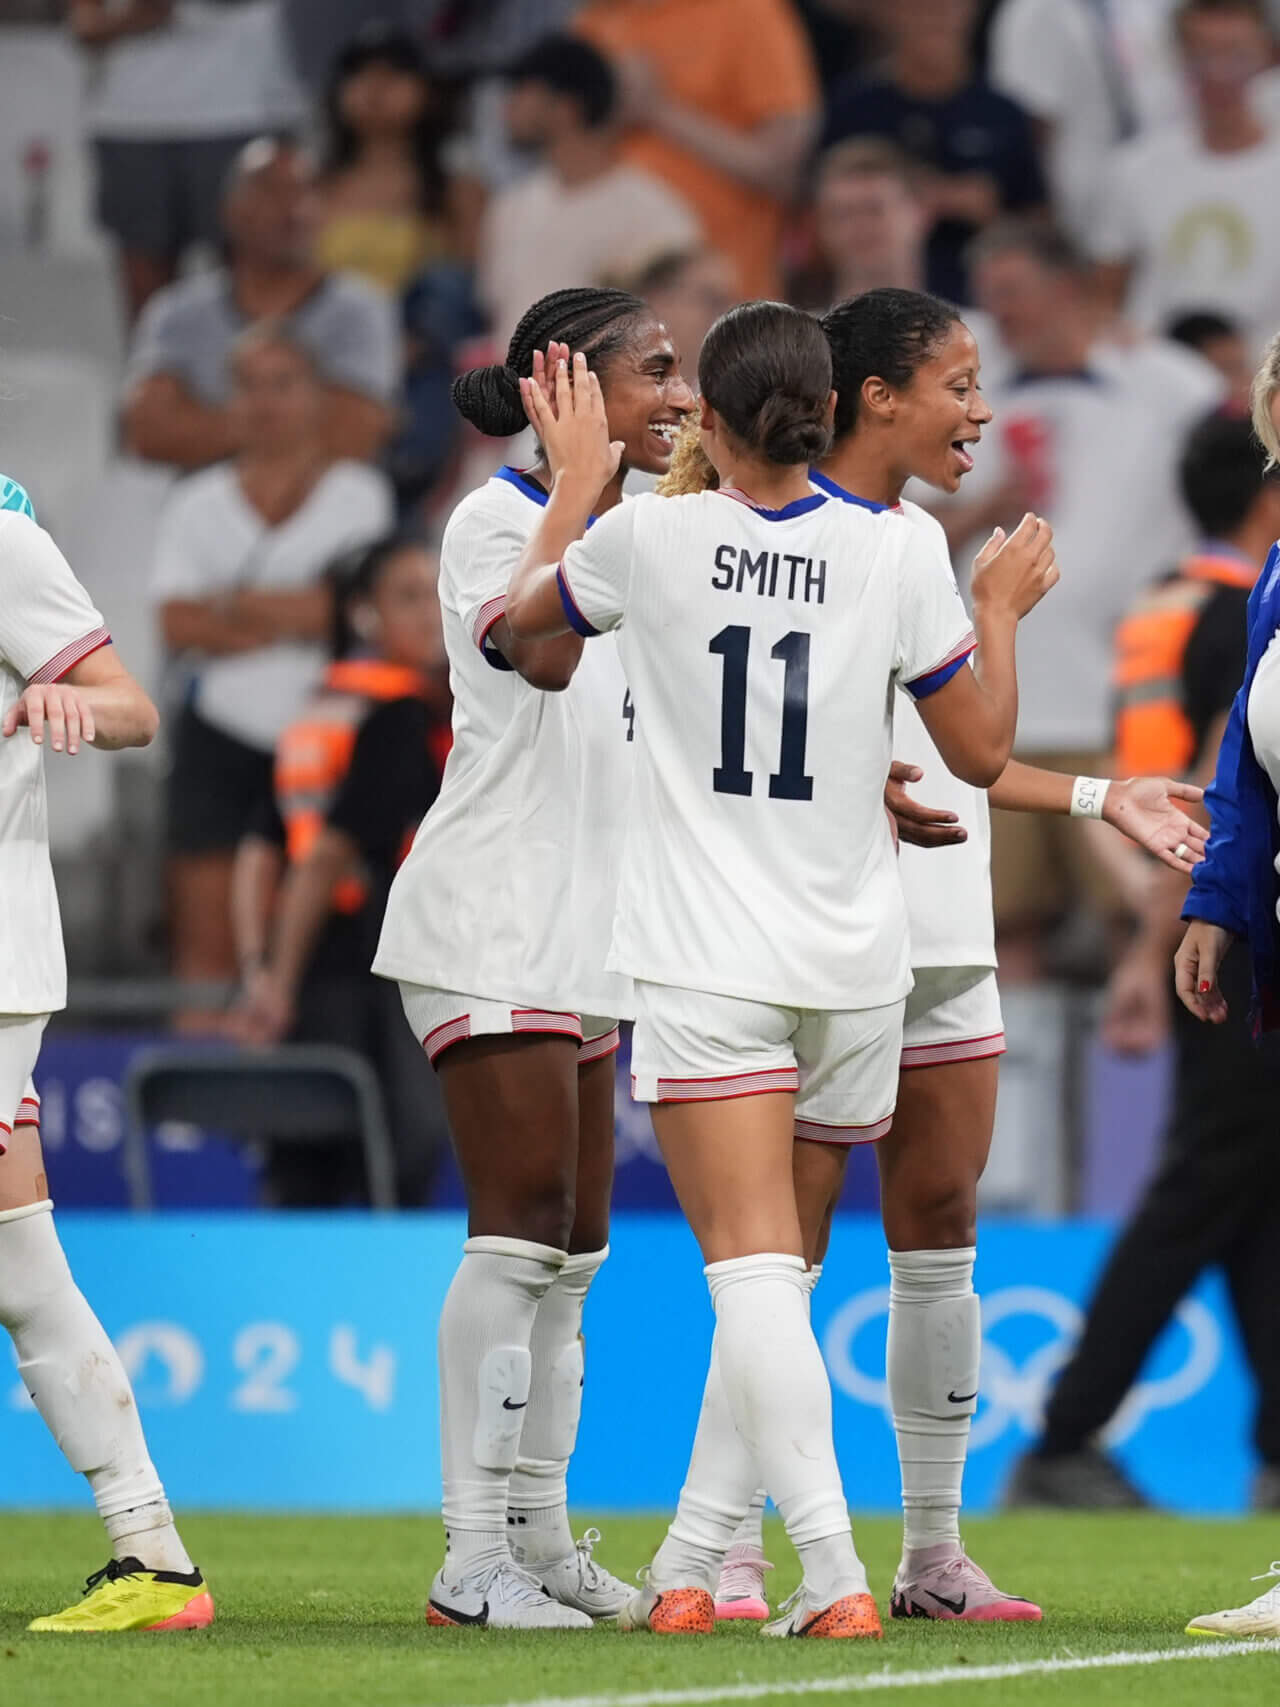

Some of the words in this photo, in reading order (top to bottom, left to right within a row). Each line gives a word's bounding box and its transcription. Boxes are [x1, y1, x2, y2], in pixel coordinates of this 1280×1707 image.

[711, 544, 827, 604] SMITH
[708, 625, 814, 801] 11
[11, 1321, 396, 1412] 024
